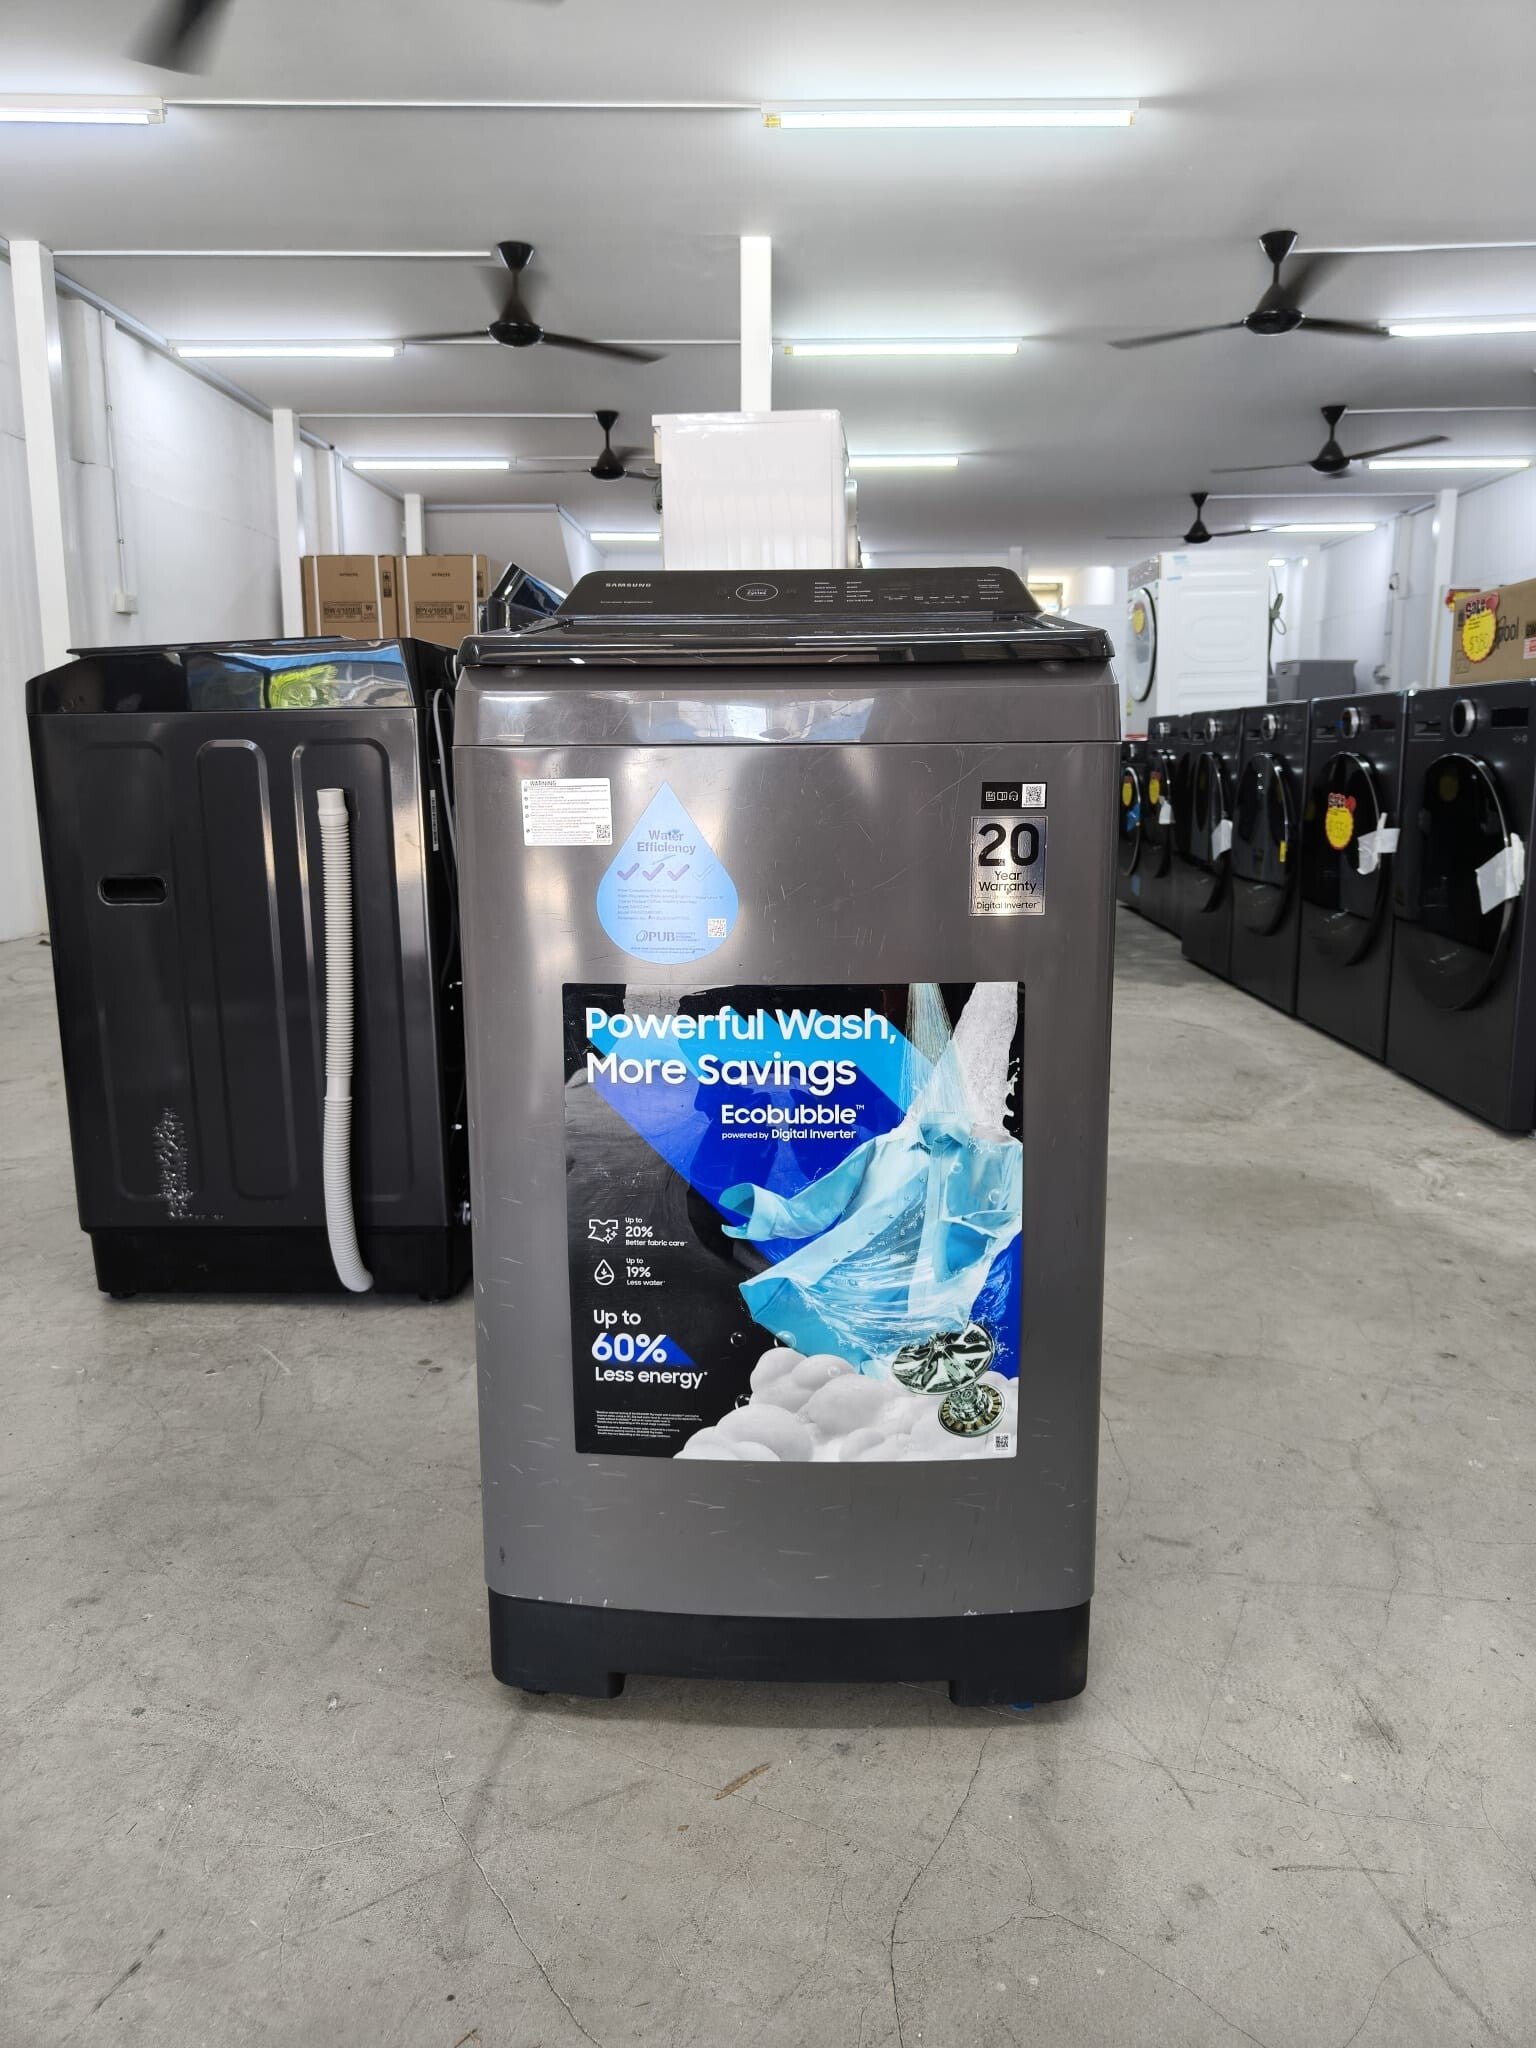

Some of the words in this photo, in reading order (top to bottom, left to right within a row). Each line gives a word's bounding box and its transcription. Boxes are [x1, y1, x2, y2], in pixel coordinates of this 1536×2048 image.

[648, 829, 684, 841] Water
[636, 841, 696, 856] Efficiency
[978, 822, 1040, 867] 20
[994, 870, 1022, 881] Year
[978, 881, 1037, 894] Warranty
[976, 901, 1003, 912] Digital
[649, 931, 676, 942] PUB
[585, 1005, 764, 1041] Powerful
[774, 1007, 897, 1045] Wash,
[586, 1052, 687, 1085] More
[697, 1051, 857, 1097] Savings
[721, 1132, 758, 1141] powered
[759, 1132, 769, 1141] by
[771, 1128, 808, 1142] Digital
[809, 1128, 857, 1139] Inverter
[624, 1217, 635, 1225] Up
[625, 1225, 653, 1238] 20%
[647, 1239, 668, 1247] fabric
[625, 1257, 636, 1266] Up
[626, 1266, 652, 1278] 19%
[593, 1309, 618, 1328] Up
[621, 1310, 642, 1326] to
[591, 1332, 668, 1364] 60%
[594, 1366, 635, 1383] Less
